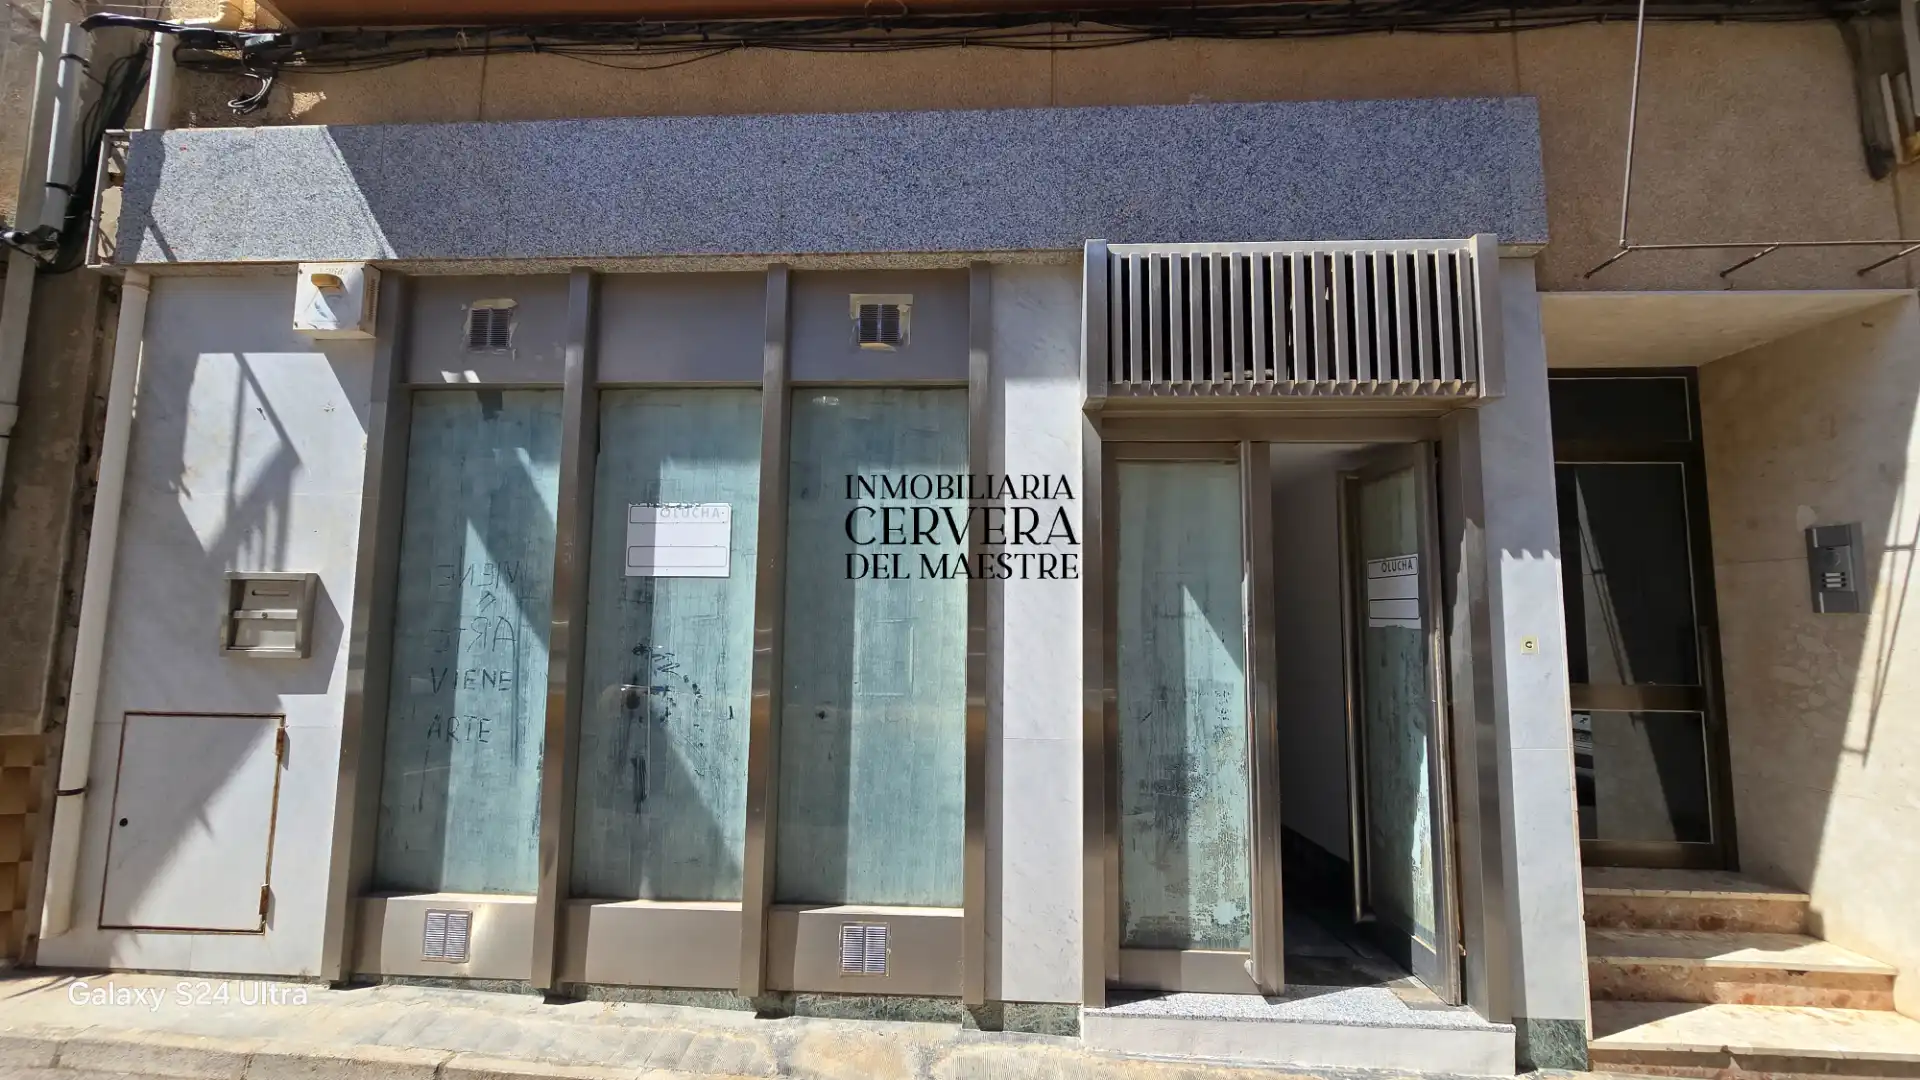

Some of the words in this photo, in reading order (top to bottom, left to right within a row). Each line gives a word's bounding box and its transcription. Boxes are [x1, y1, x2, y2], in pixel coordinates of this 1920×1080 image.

[659, 506, 720, 519] OLUCHA
[1381, 559, 1414, 573] OLUCHA
[430, 667, 513, 694] VIENE
[427, 714, 492, 743] ARTE
